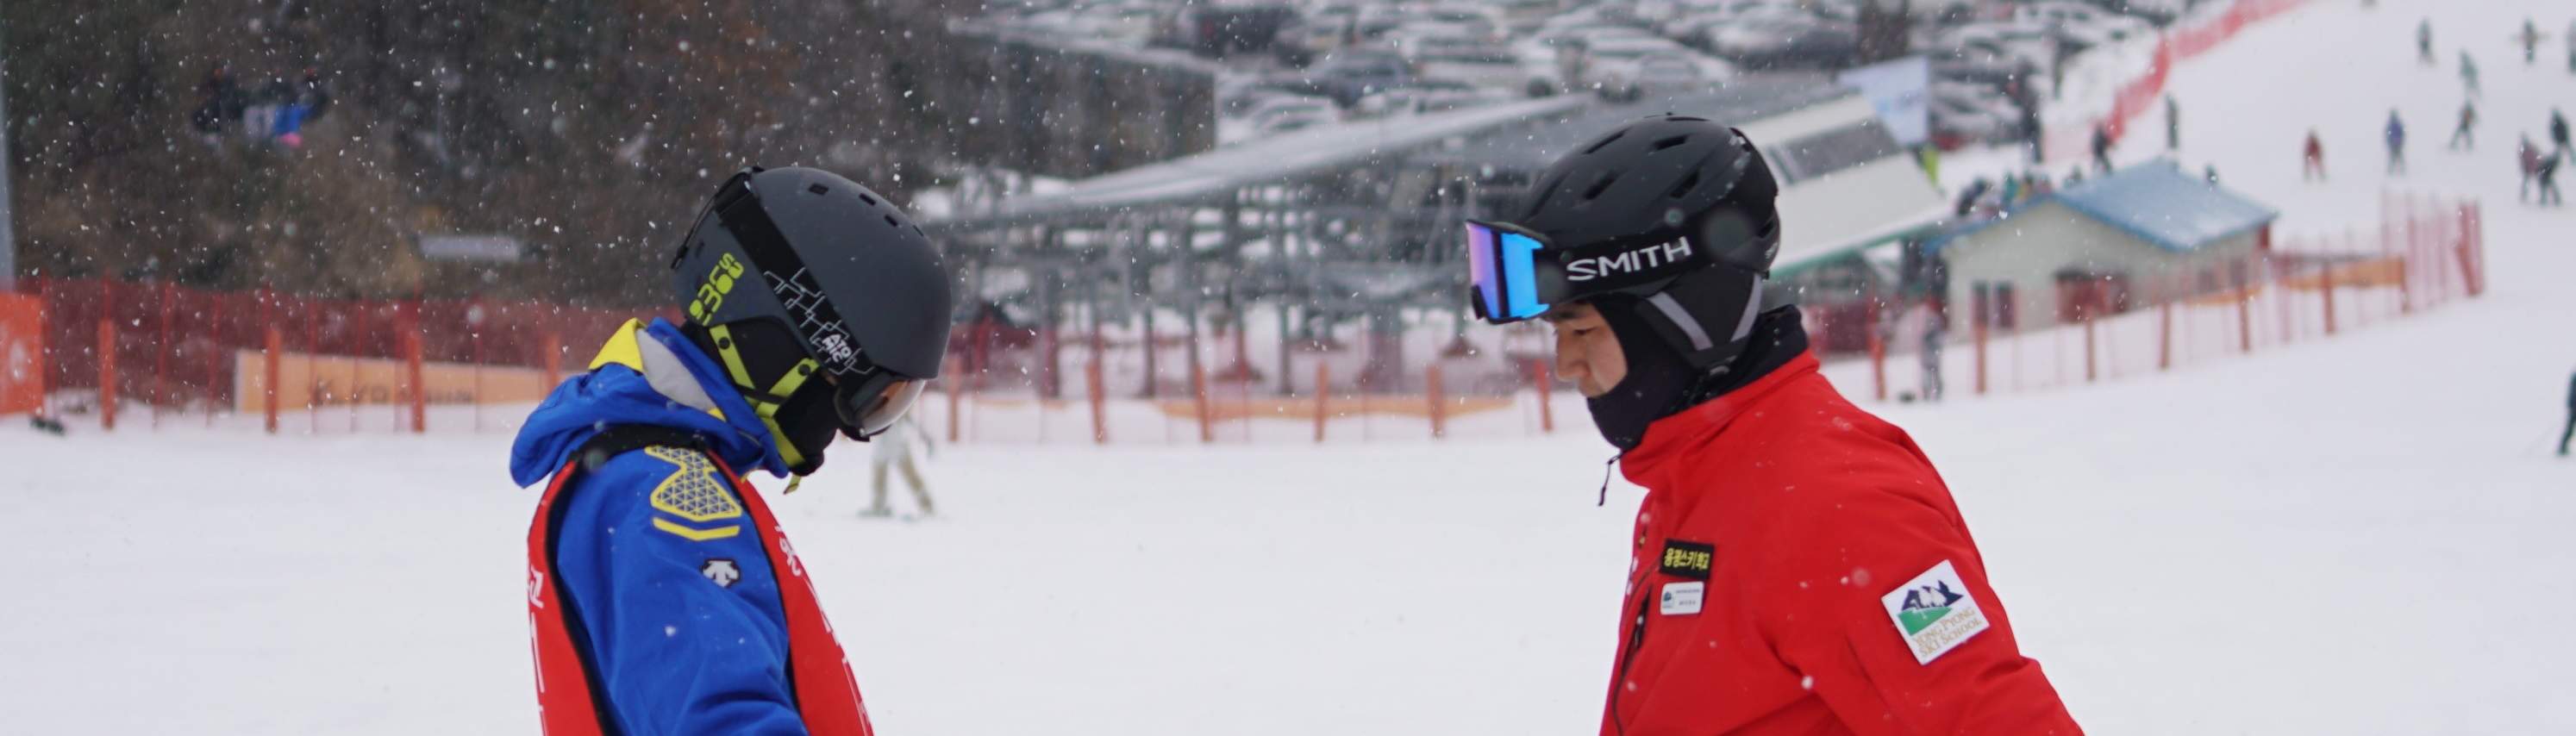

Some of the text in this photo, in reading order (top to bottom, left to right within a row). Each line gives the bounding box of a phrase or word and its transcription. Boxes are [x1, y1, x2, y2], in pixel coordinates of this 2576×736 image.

[1566, 236, 1692, 281] SMITH
[1918, 617, 1982, 657] SKI SCHOOL
[1939, 607, 1976, 631] PYONG
